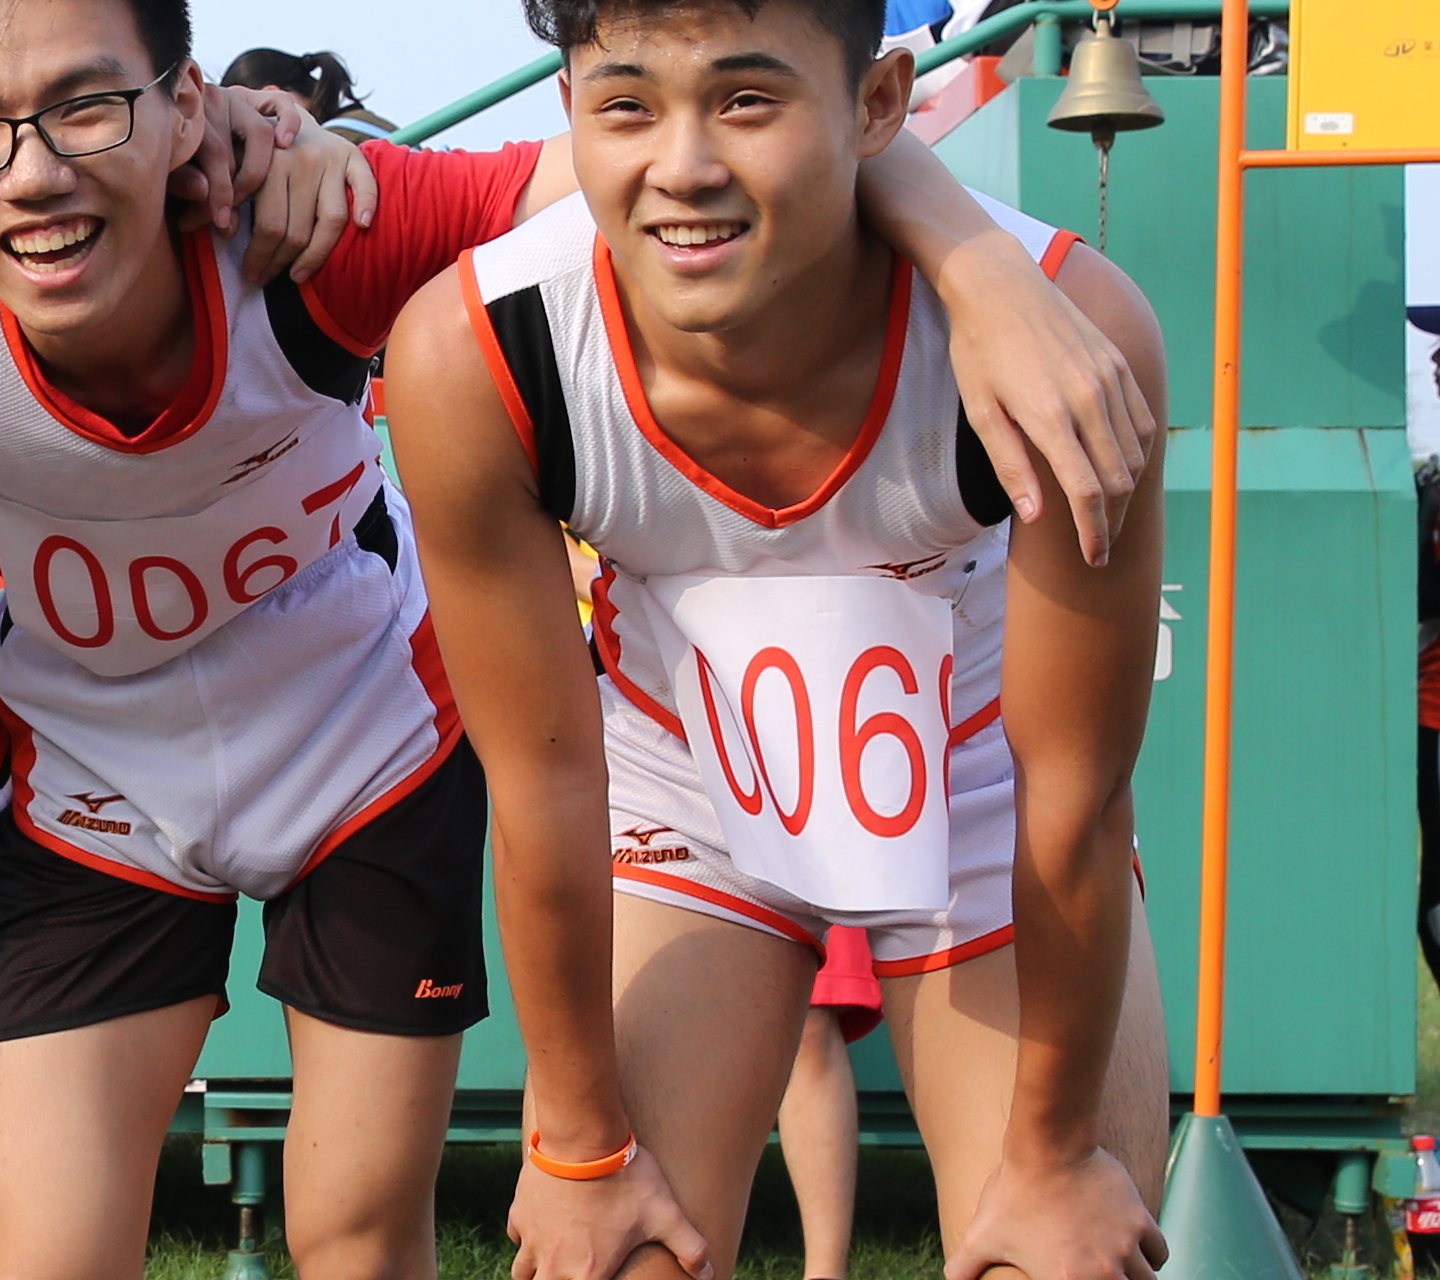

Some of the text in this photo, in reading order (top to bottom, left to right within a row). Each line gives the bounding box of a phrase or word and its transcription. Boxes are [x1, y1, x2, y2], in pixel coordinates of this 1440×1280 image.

[690, 644, 954, 839] 006
[55, 808, 132, 837] MIZUNO
[612, 846, 690, 864] MIZUNO
[414, 978, 464, 999] Bonny
